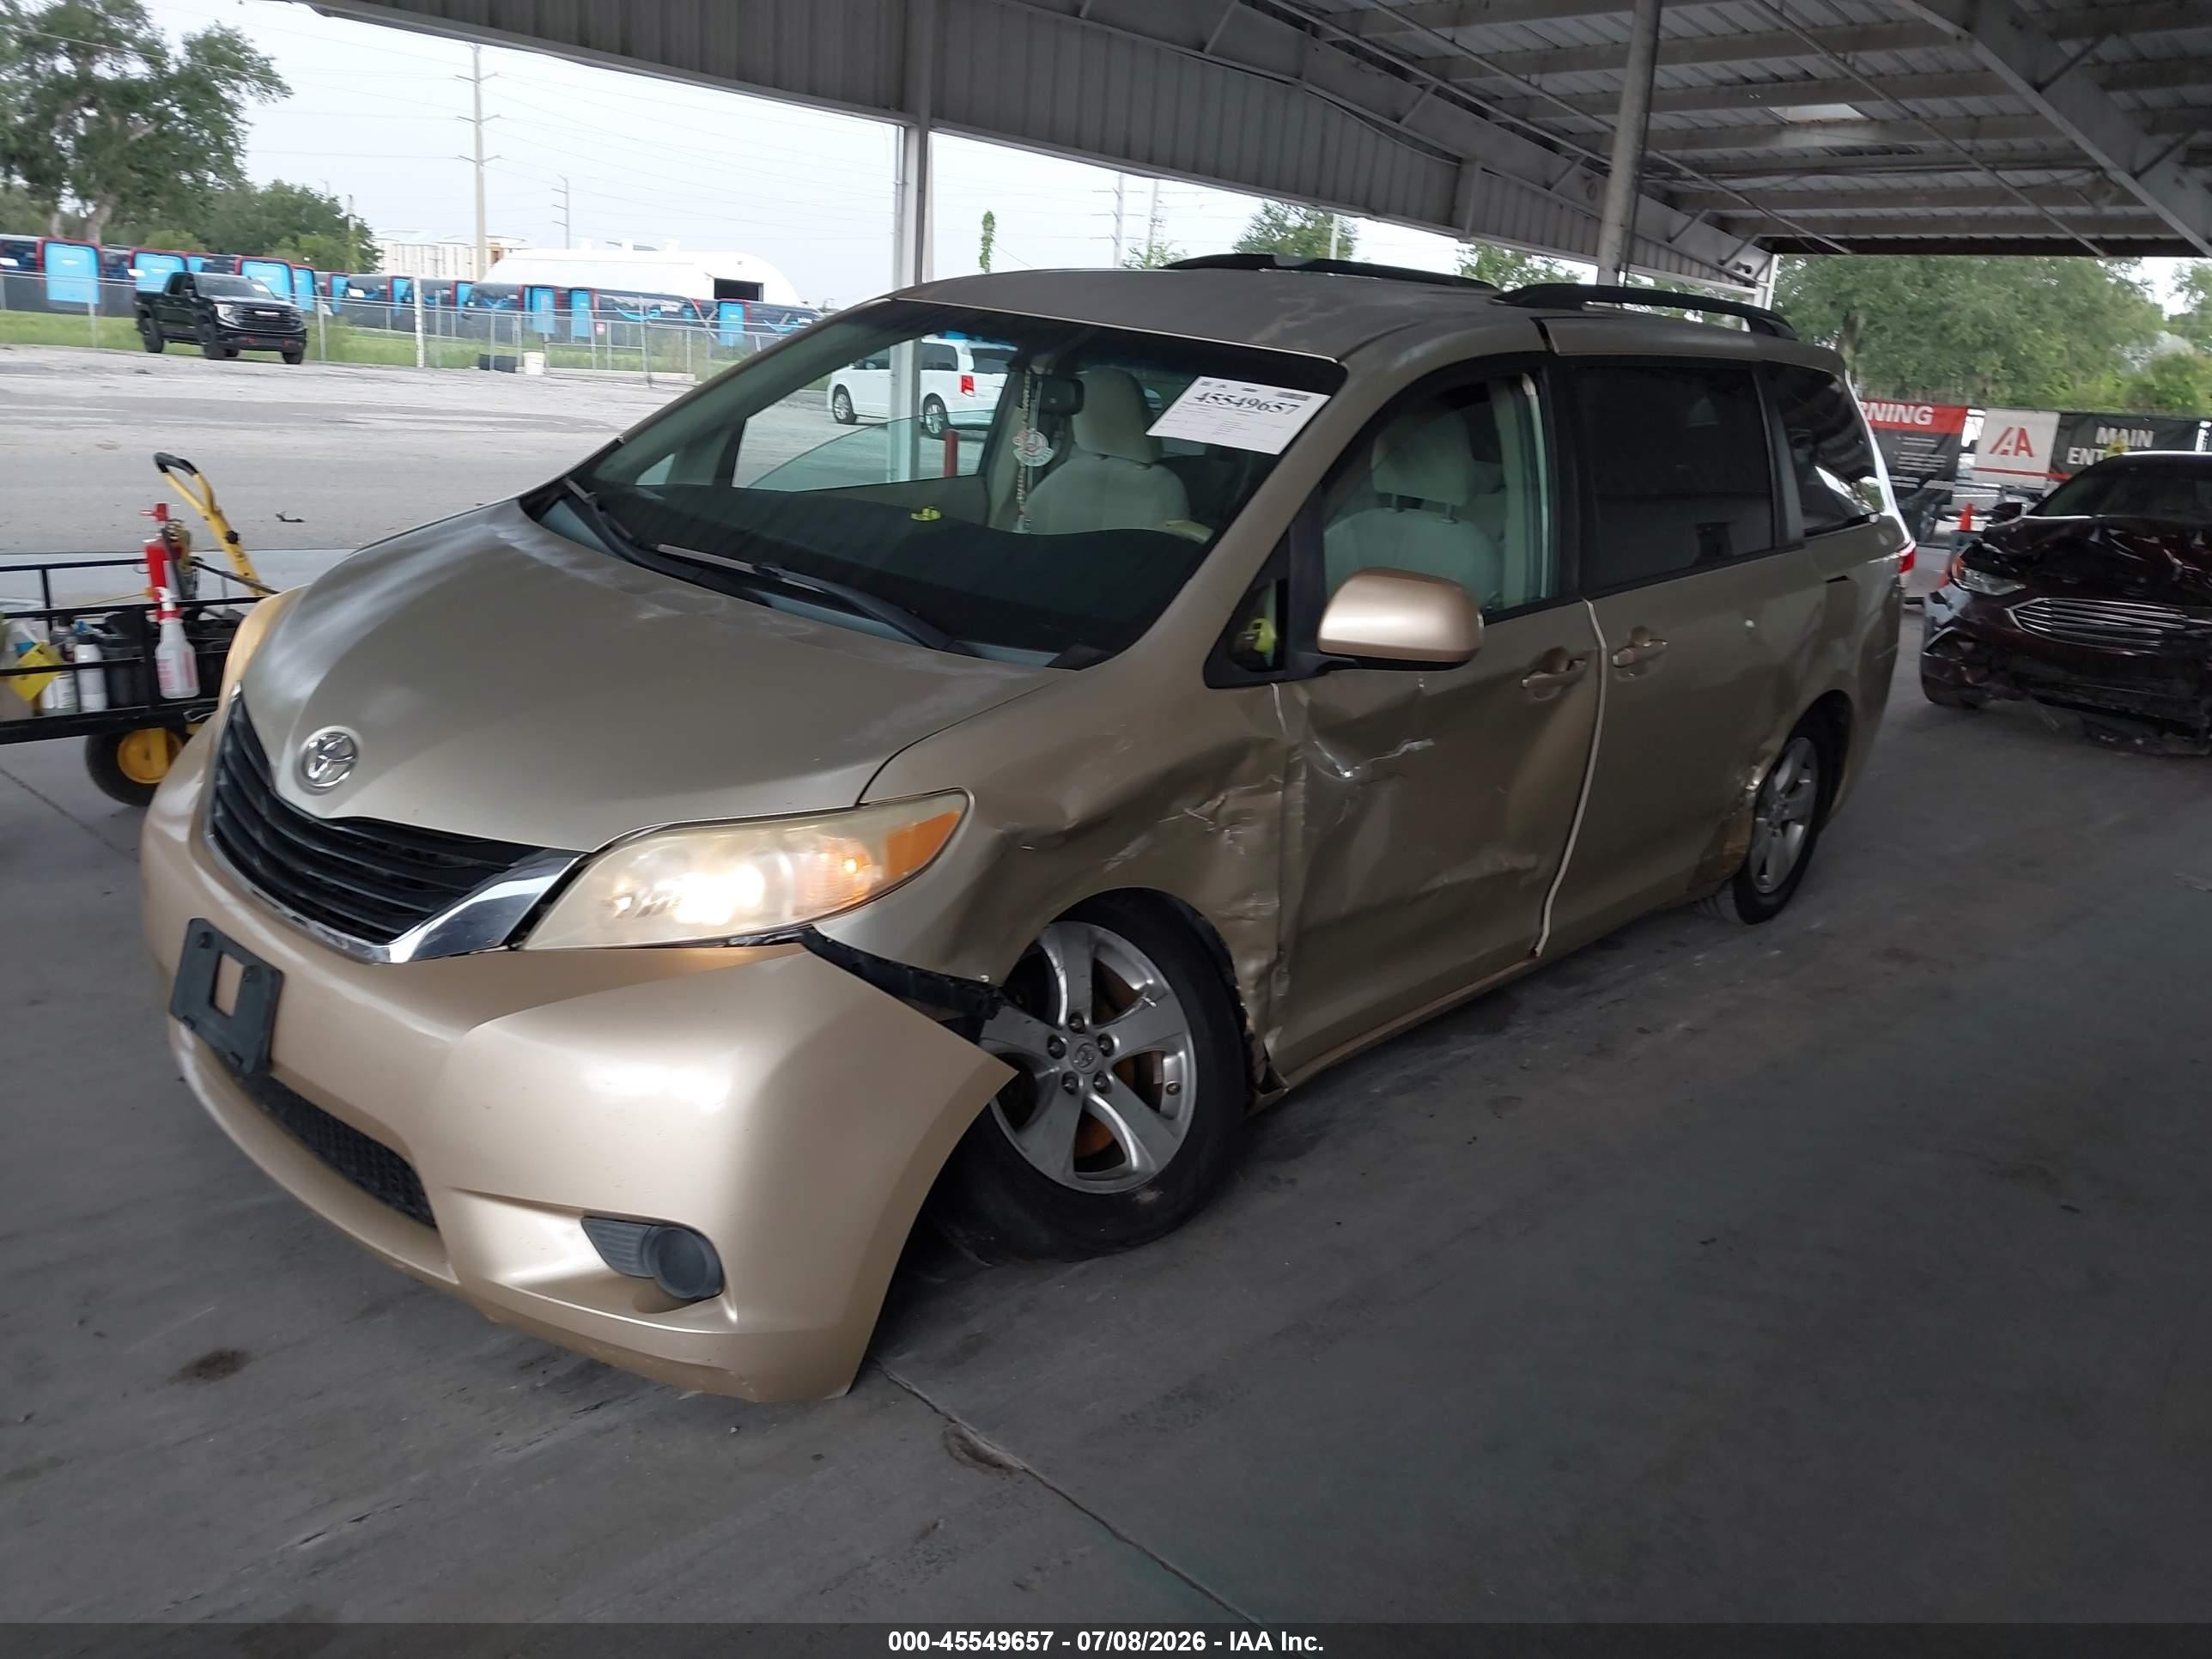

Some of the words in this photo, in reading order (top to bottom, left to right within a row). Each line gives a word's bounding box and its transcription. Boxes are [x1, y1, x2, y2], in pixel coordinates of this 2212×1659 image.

[1194, 392, 1301, 415] 45549657
[2095, 426, 2155, 448] MAIN
[2066, 447, 2106, 466] ENT
